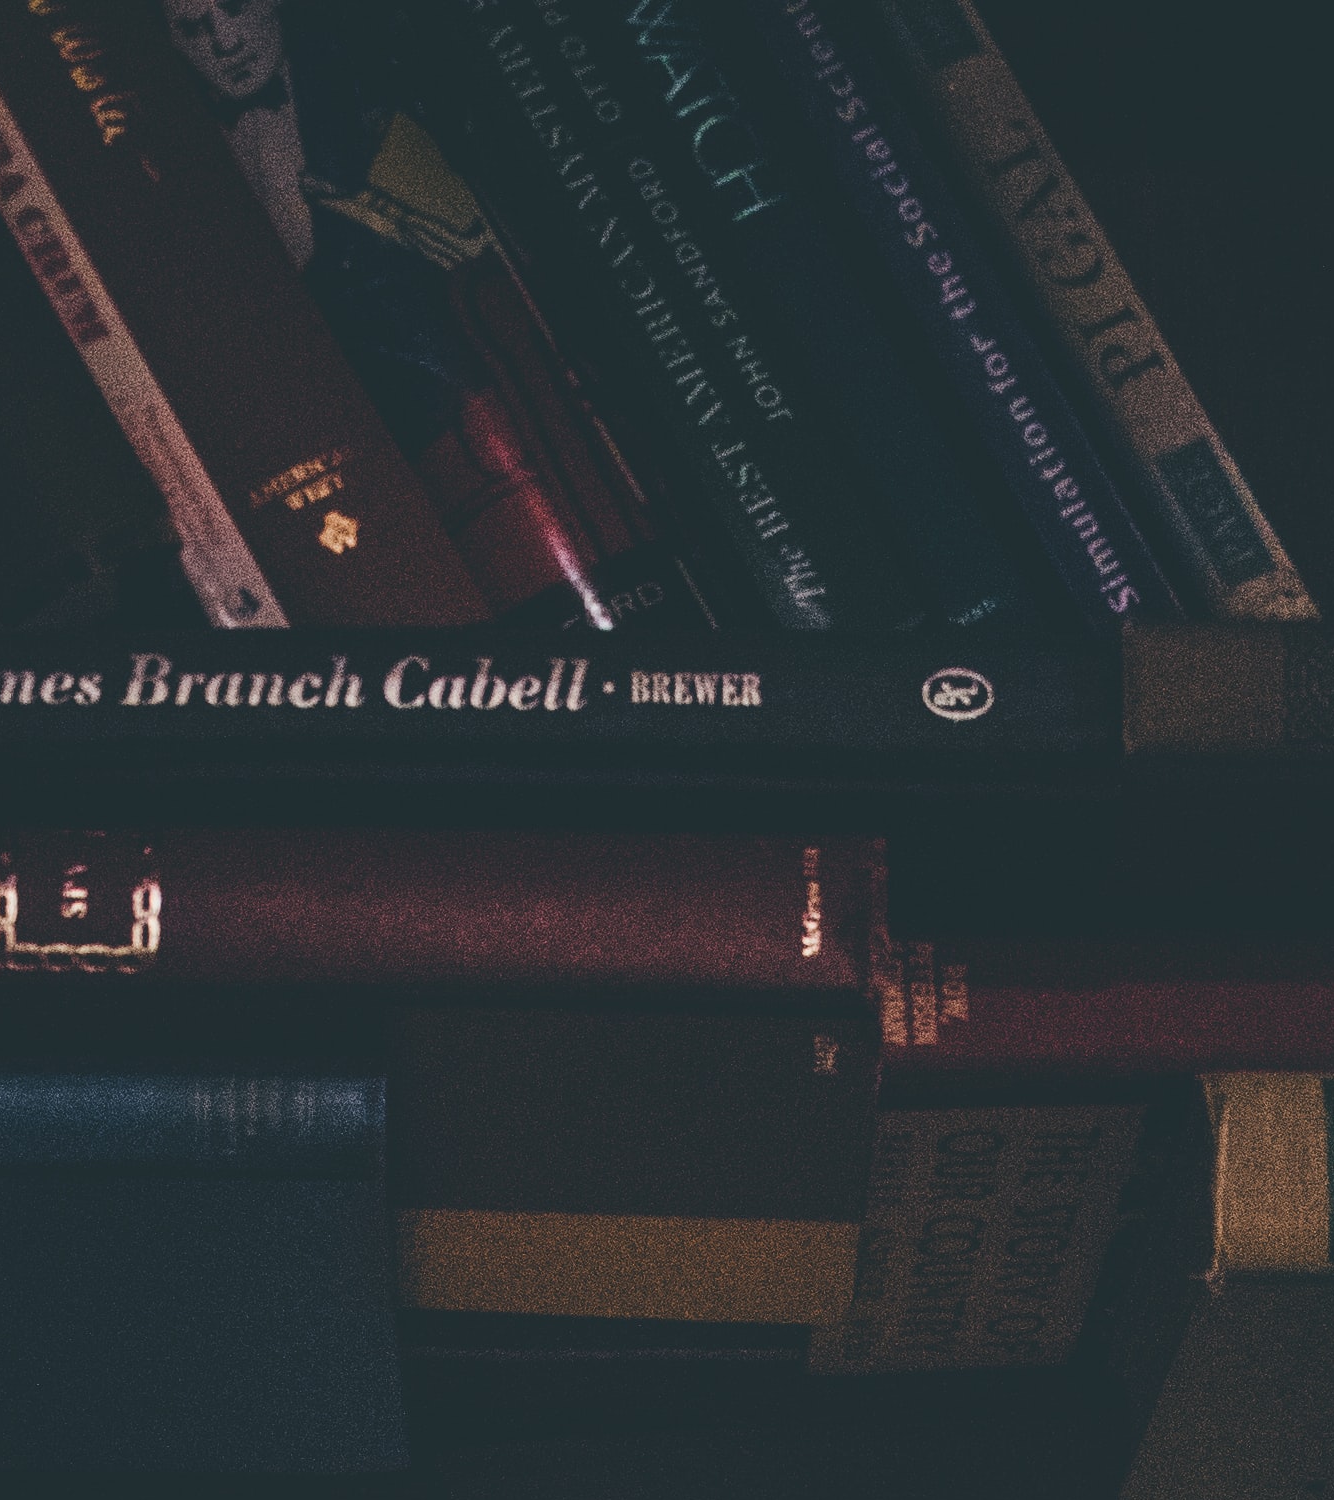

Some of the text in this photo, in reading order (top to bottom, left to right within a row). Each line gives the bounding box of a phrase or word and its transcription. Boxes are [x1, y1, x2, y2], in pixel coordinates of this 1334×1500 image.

[484, 22, 602, 212] MYSTERY
[559, 34, 623, 124] OTTO
[627, 0, 783, 224] WATCH
[852, 126, 938, 250] Social
[17, 206, 112, 345] CRUM
[589, 217, 734, 430] AMERICAN
[627, 157, 795, 423] JOHN SANDFORD
[926, 249, 979, 321] the
[969, 328, 1021, 396] for
[711, 440, 791, 541] BEST
[1007, 396, 1142, 614] Simulation
[119, 652, 366, 711] Branch
[382, 654, 590, 712] Cabell
[629, 672, 763, 709] BREWER
